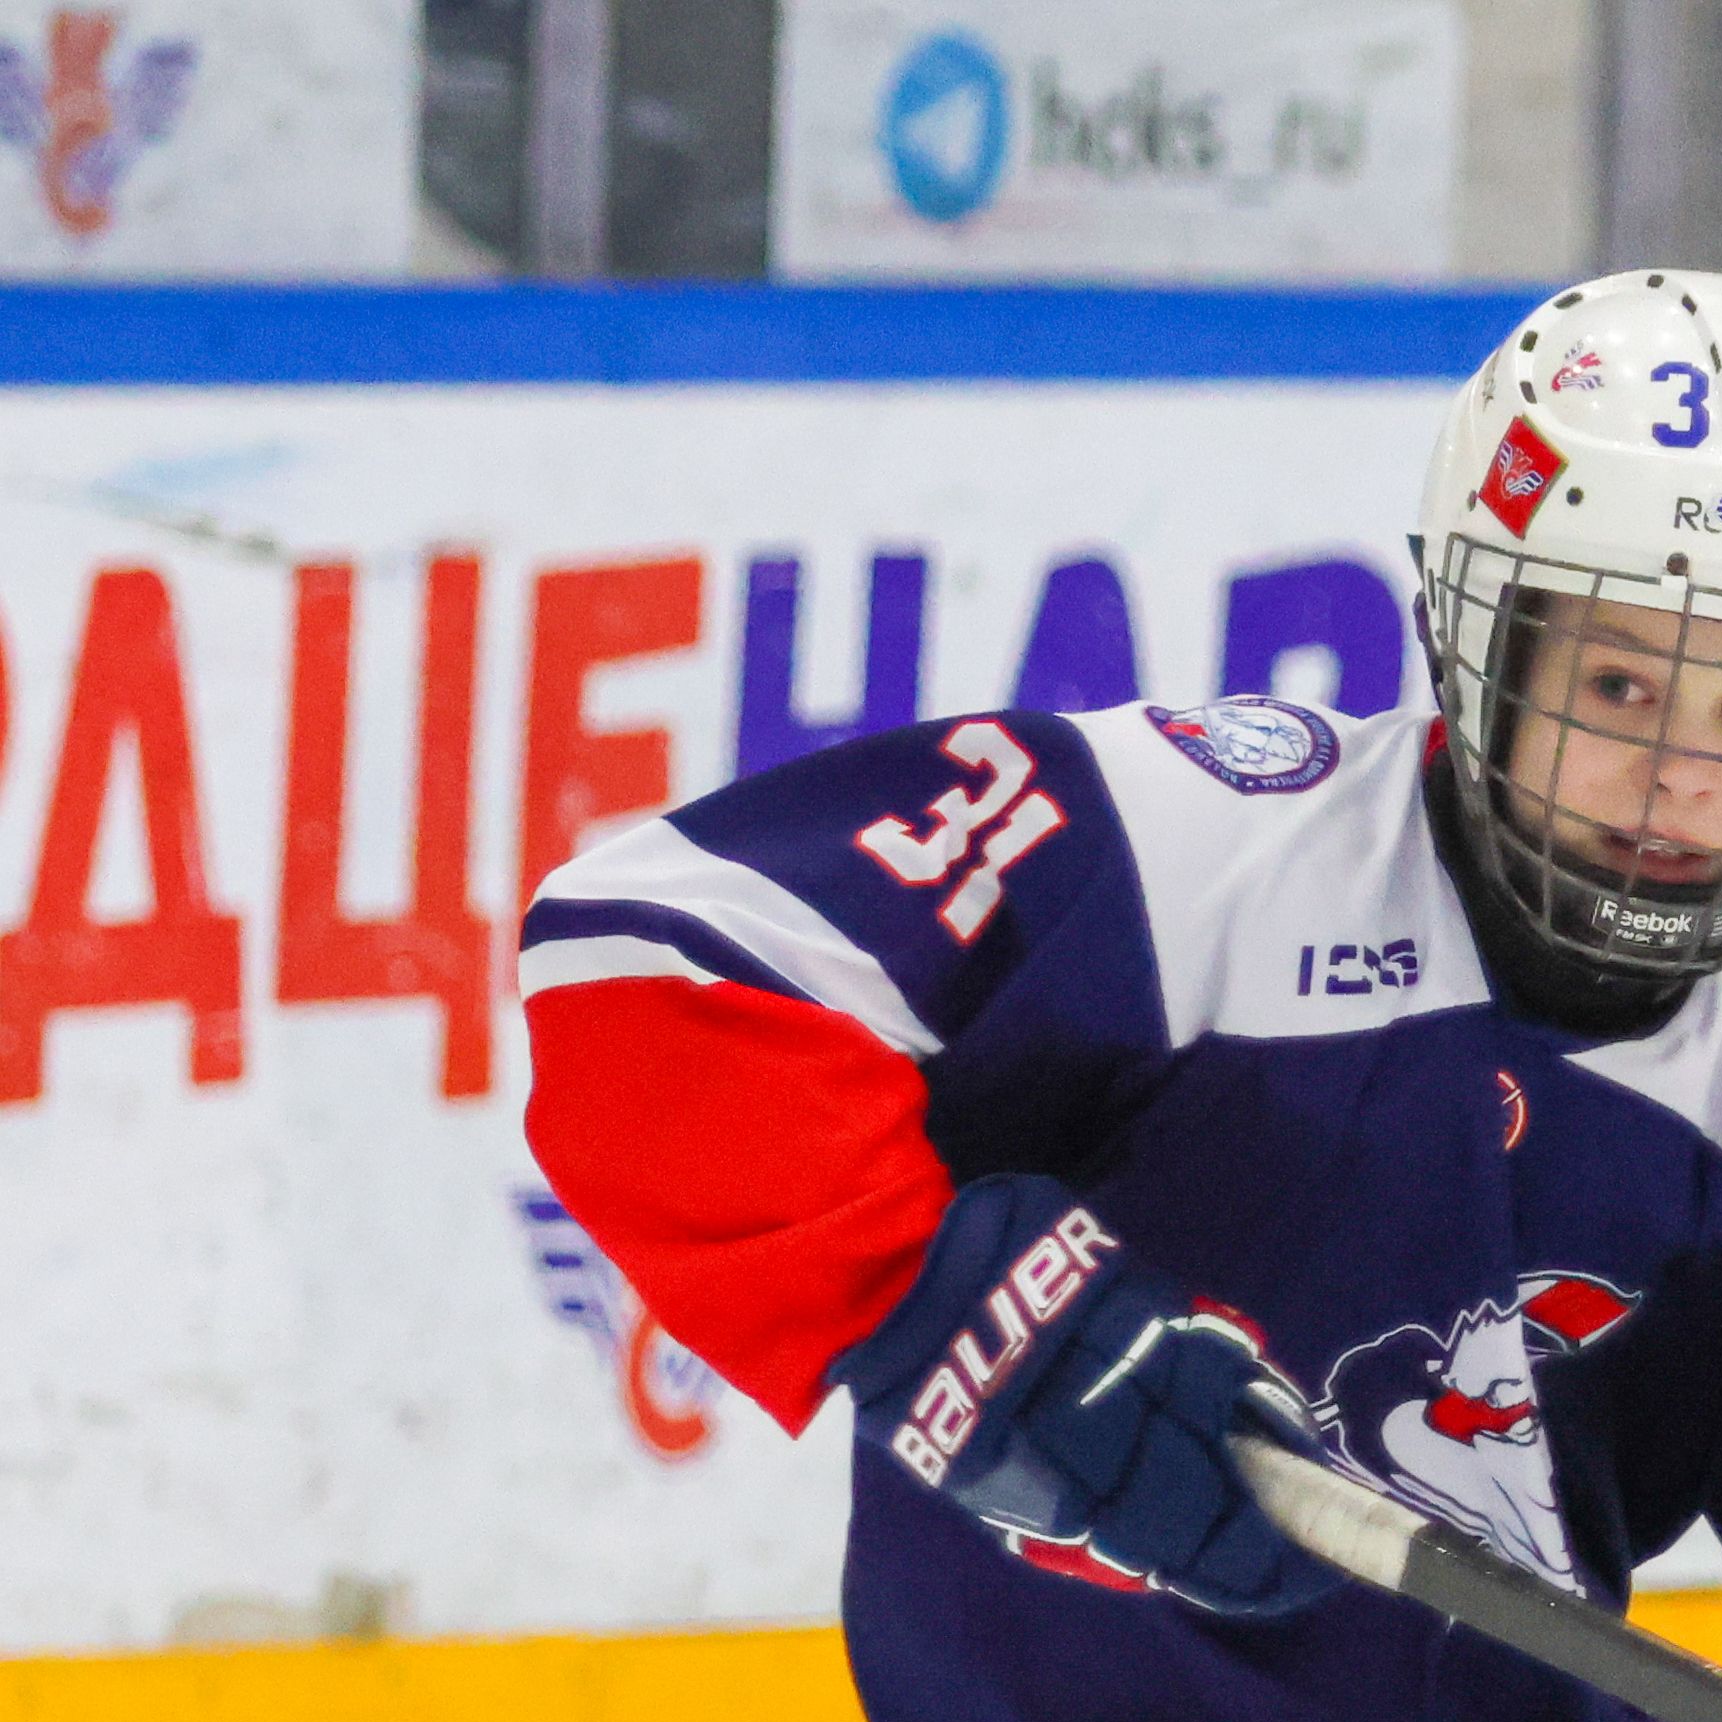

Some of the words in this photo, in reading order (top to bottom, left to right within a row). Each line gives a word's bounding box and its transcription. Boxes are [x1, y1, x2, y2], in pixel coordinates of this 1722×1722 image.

[853, 717, 1070, 946] 31
[1600, 899, 1693, 933] Reebok
[891, 1207, 1120, 1490] BAUER
